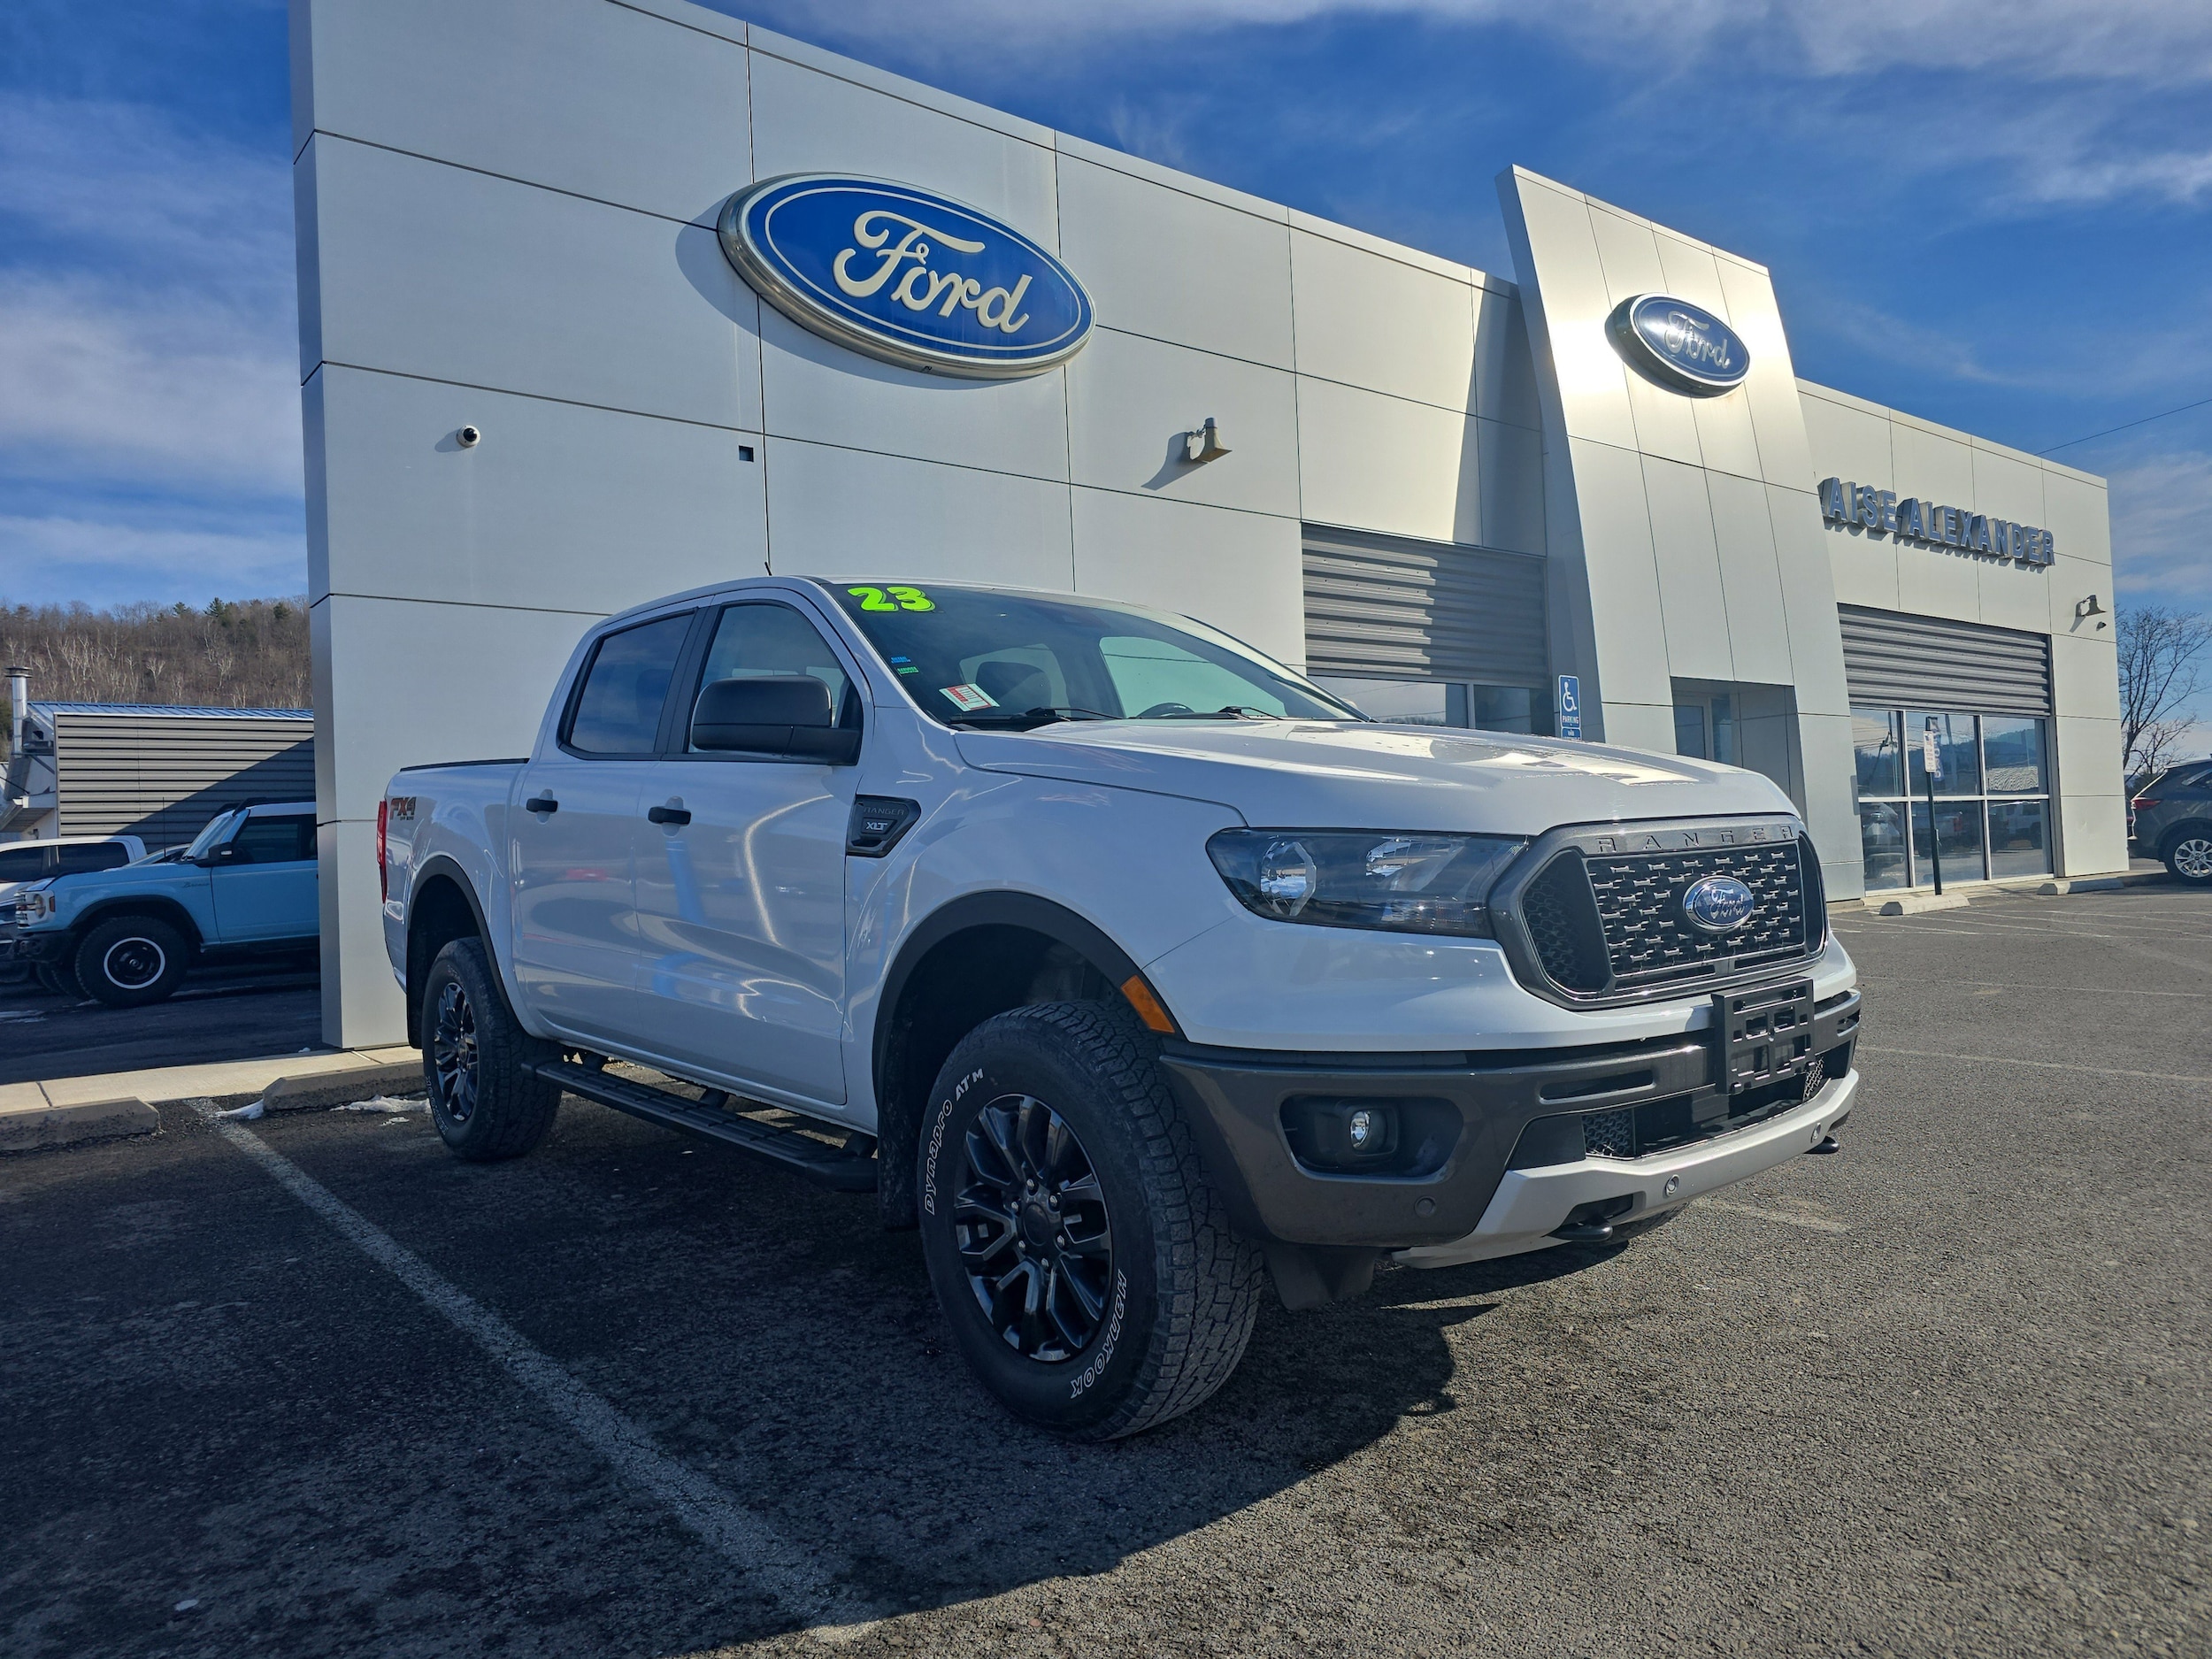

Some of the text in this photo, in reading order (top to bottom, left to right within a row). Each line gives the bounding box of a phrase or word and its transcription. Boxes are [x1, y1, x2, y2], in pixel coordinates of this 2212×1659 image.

[833, 211, 1033, 334] Ford
[1664, 311, 1731, 369] Ford
[1821, 477, 2055, 566] AISE ALEXANDER
[848, 587, 936, 612] 23
[1562, 715, 1579, 724] PARKING
[389, 796, 417, 820] FX4
[866, 822, 887, 831] XLT
[1595, 826, 1794, 854] RANGER
[1709, 887, 1746, 919] Ford
